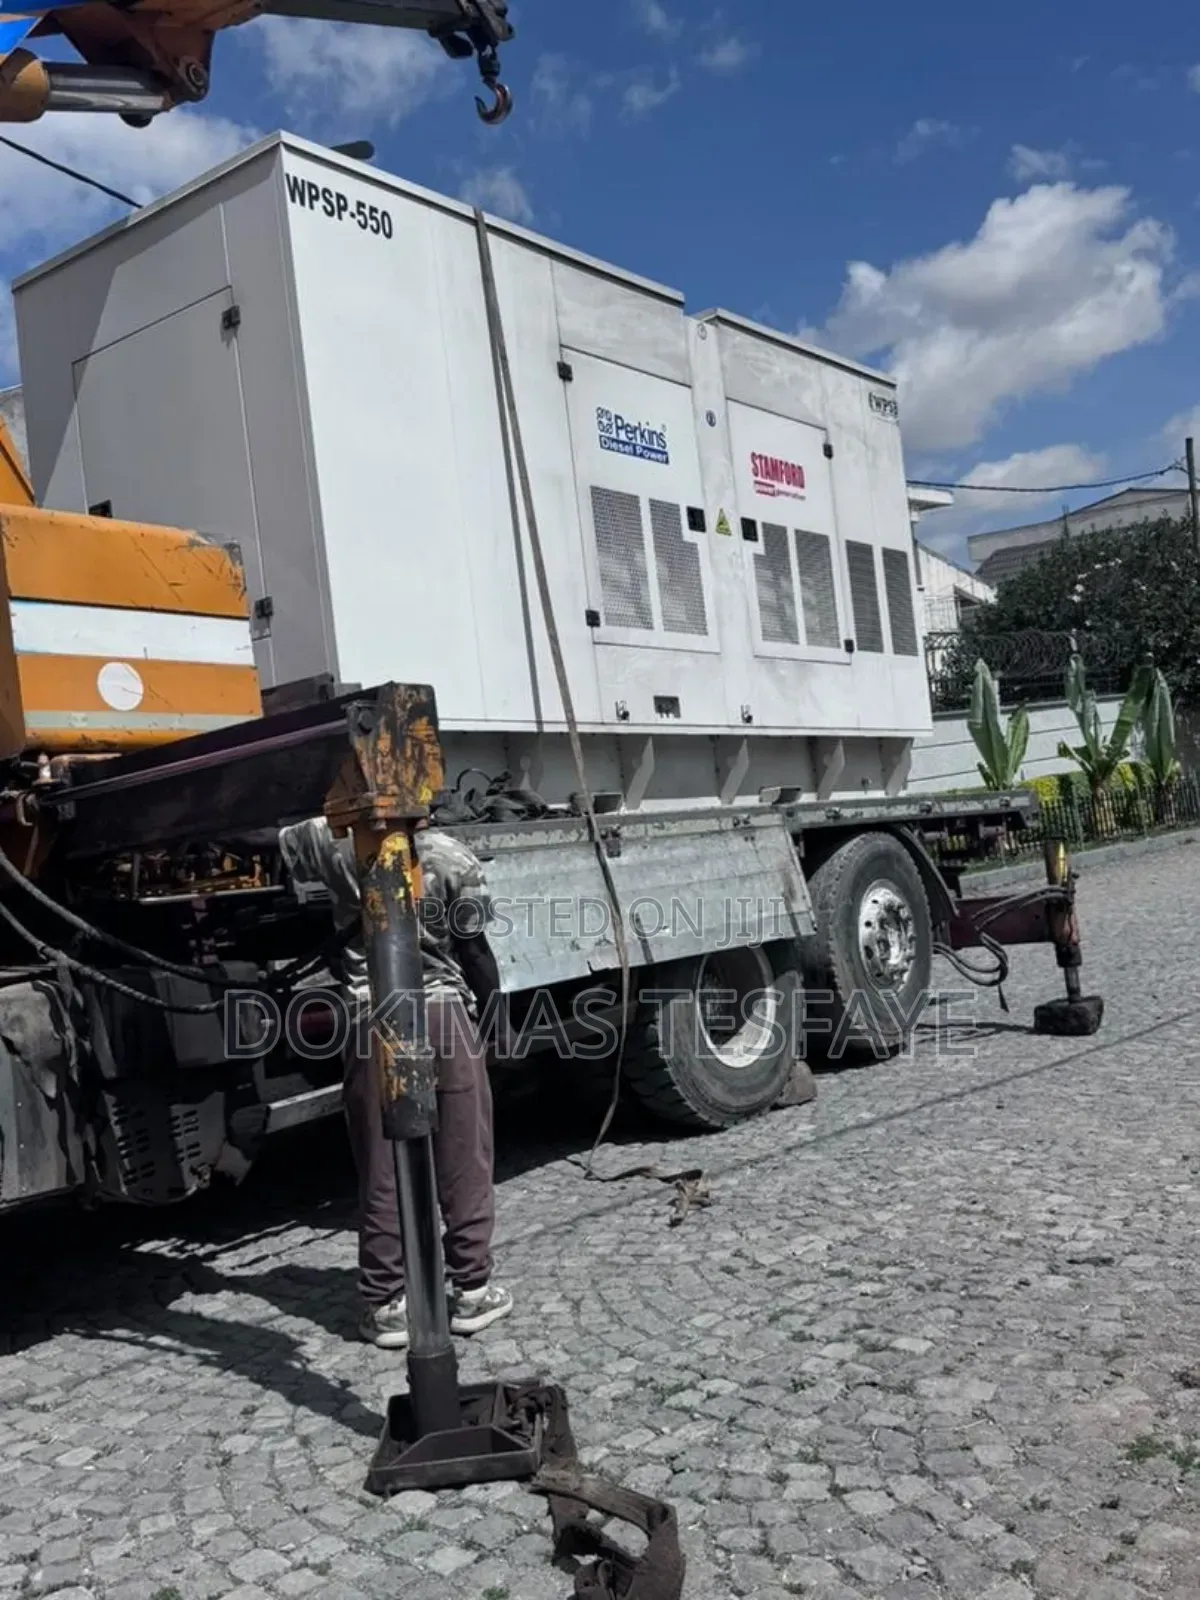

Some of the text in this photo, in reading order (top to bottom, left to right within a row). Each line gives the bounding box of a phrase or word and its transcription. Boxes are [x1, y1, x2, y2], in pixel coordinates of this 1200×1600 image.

[285, 172, 393, 240] WPSP-550
[614, 413, 667, 450] Perkins
[751, 451, 805, 489] STAMFORD
